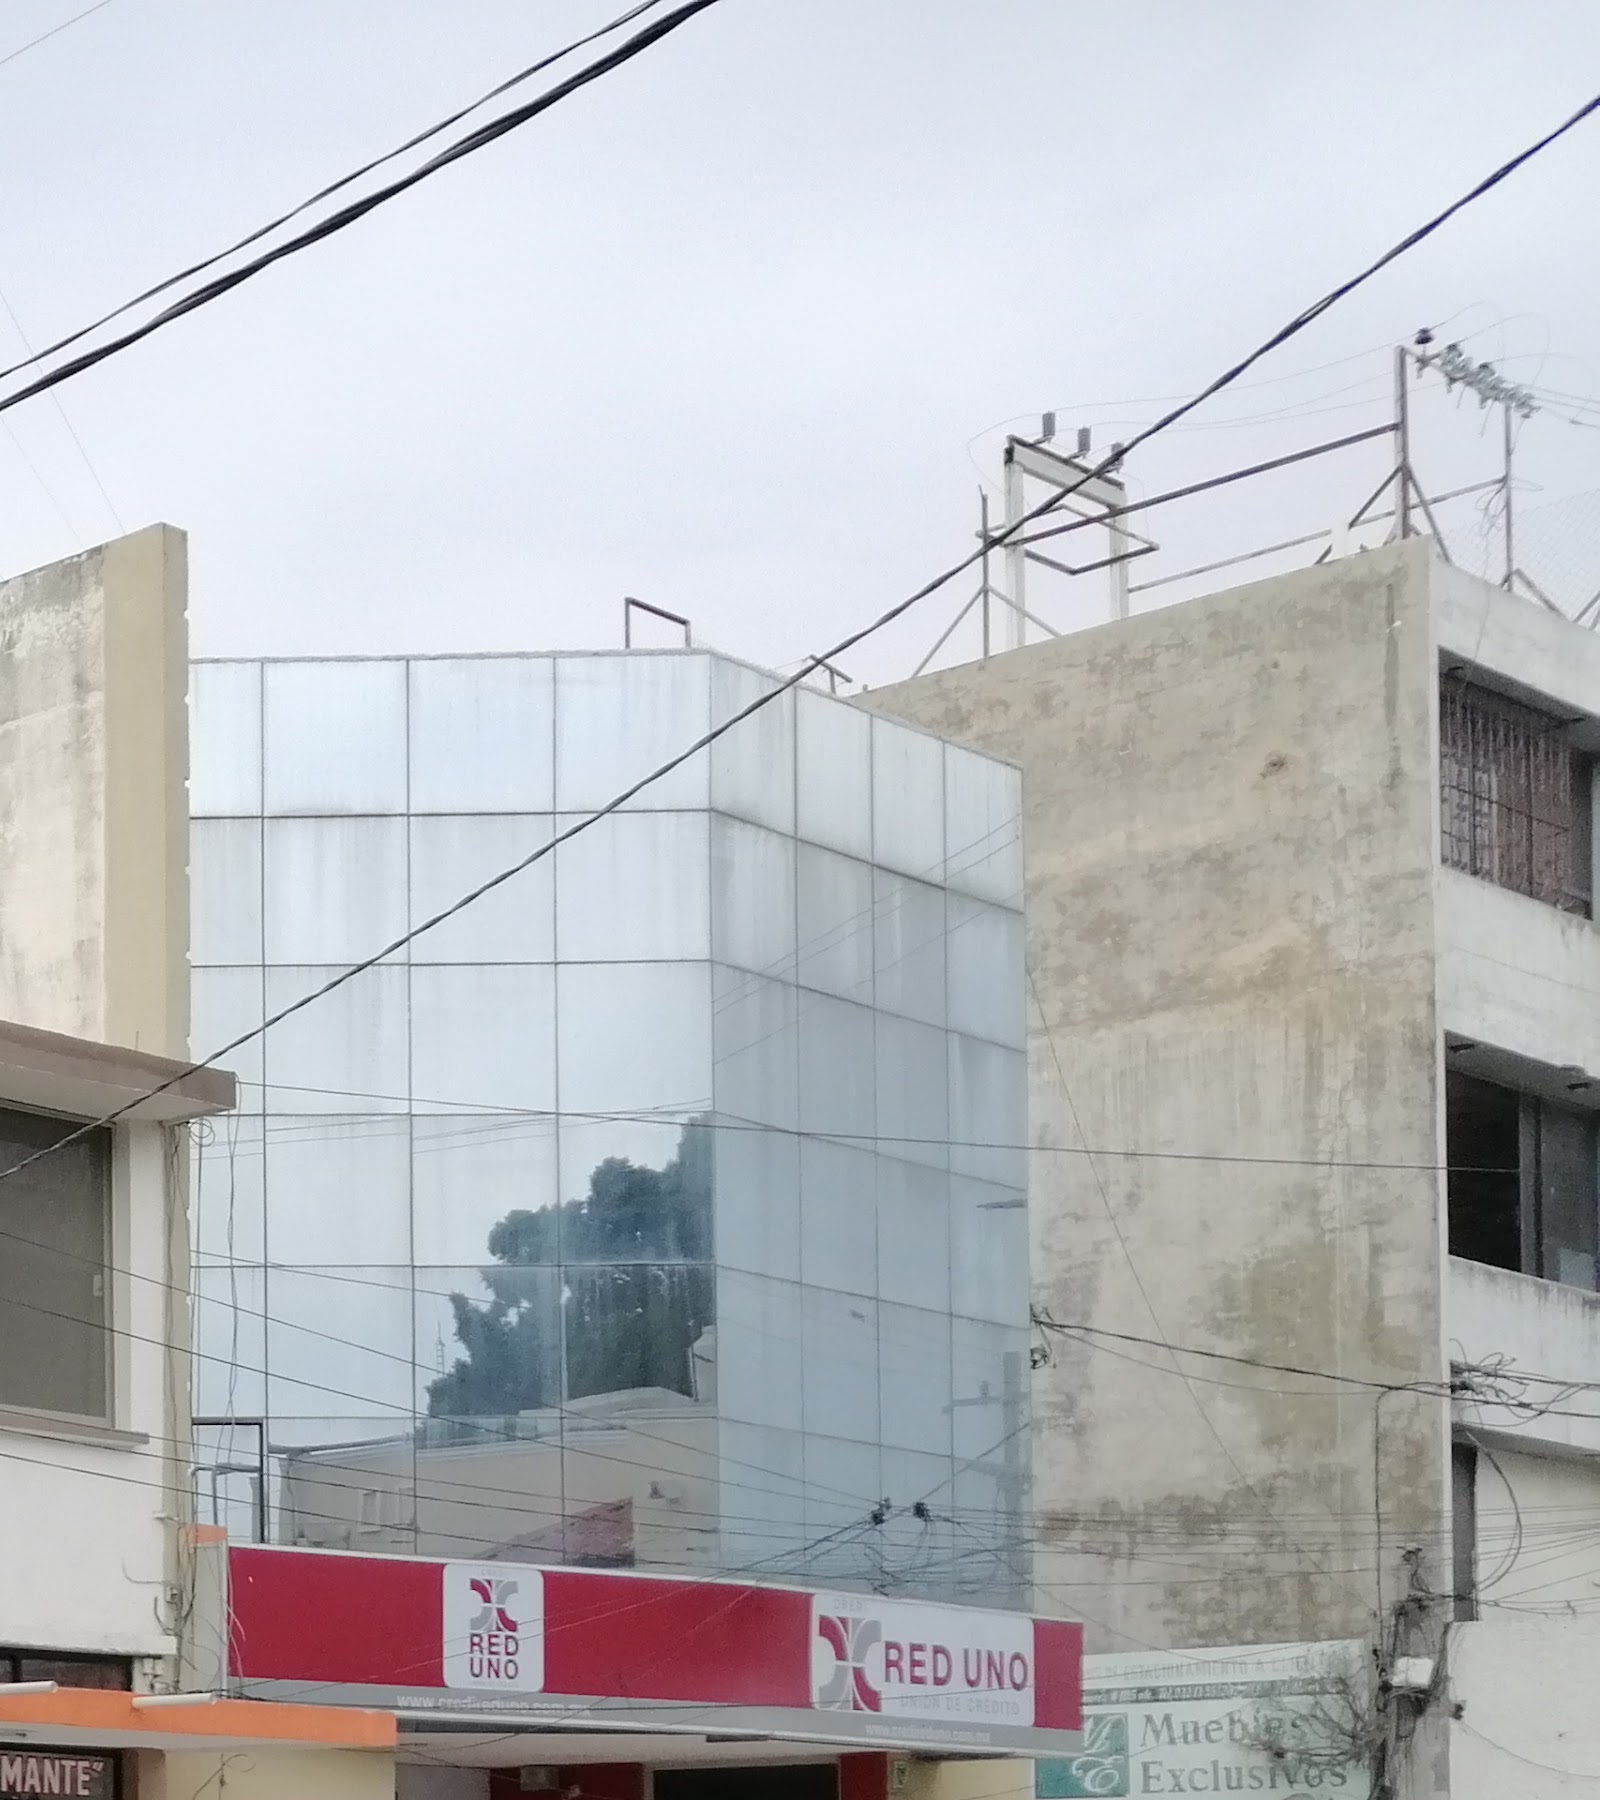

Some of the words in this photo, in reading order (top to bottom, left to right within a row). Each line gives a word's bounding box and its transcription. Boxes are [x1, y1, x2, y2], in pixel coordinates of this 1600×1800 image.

[469, 1632, 519, 1656] RED
[469, 1656, 519, 1680] UNO
[883, 1640, 953, 1687] RED
[963, 1647, 1028, 1692] UNO
[1140, 1759, 1347, 1795] Exclusivos
